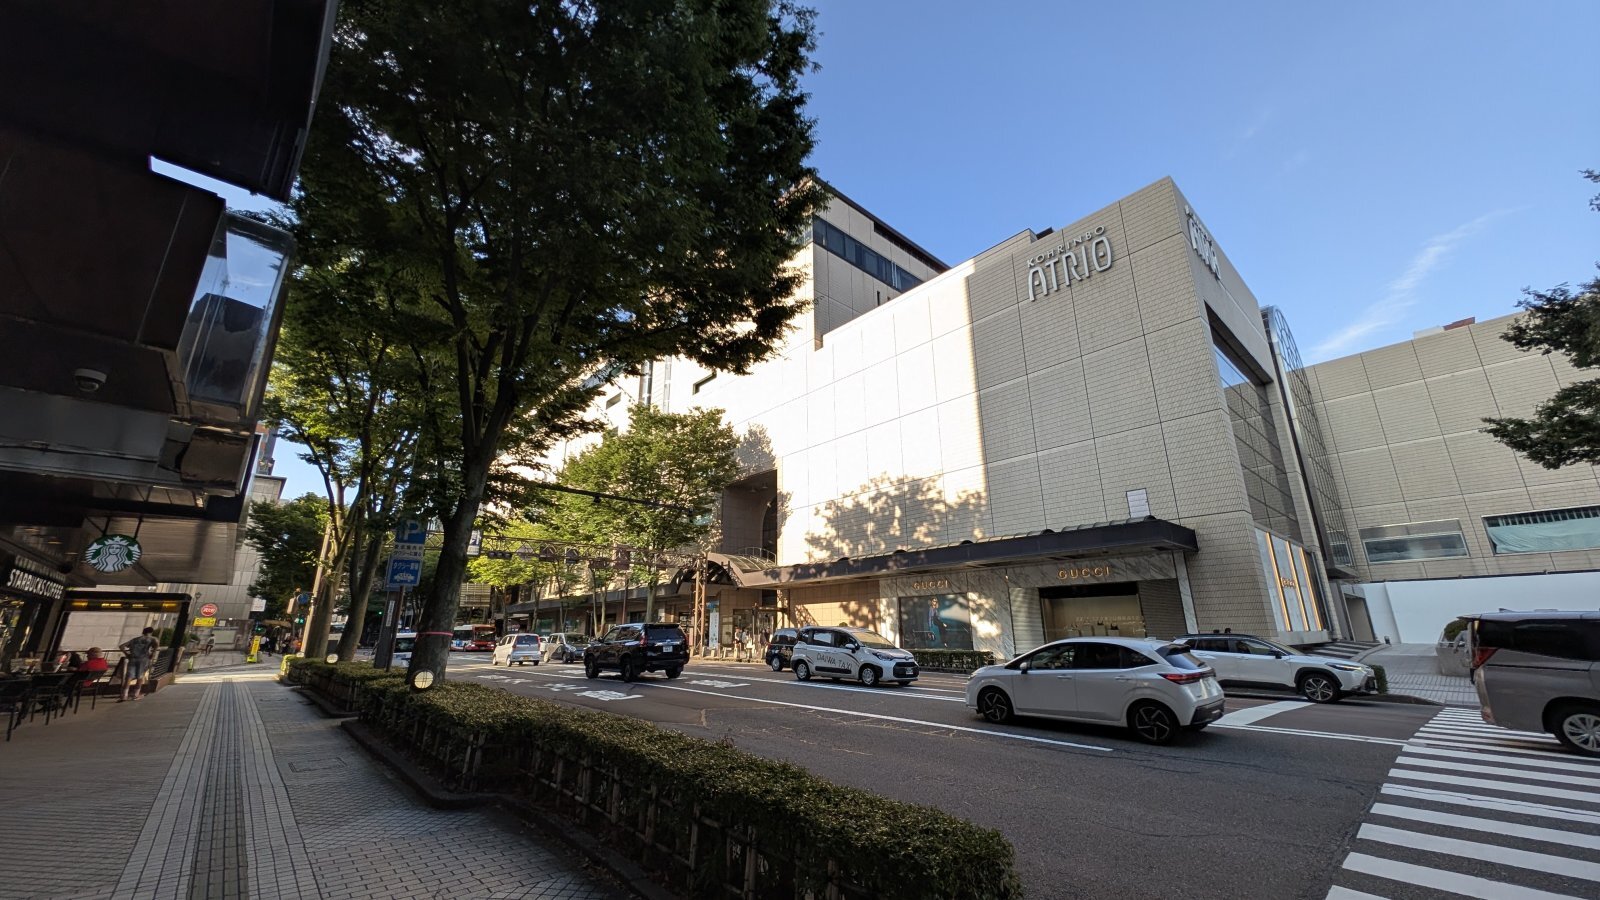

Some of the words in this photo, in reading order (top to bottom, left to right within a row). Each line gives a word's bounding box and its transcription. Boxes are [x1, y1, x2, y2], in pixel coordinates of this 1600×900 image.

[1027, 225, 1105, 268] KOHRINBO
[1028, 236, 1112, 302] ATRIO
[7, 568, 46, 595] STARBUCKS
[44, 580, 63, 599] COFFEE
[1058, 566, 1110, 580] GUCCI
[913, 579, 948, 590] GUCCI
[838, 660, 852, 670] TAXI
